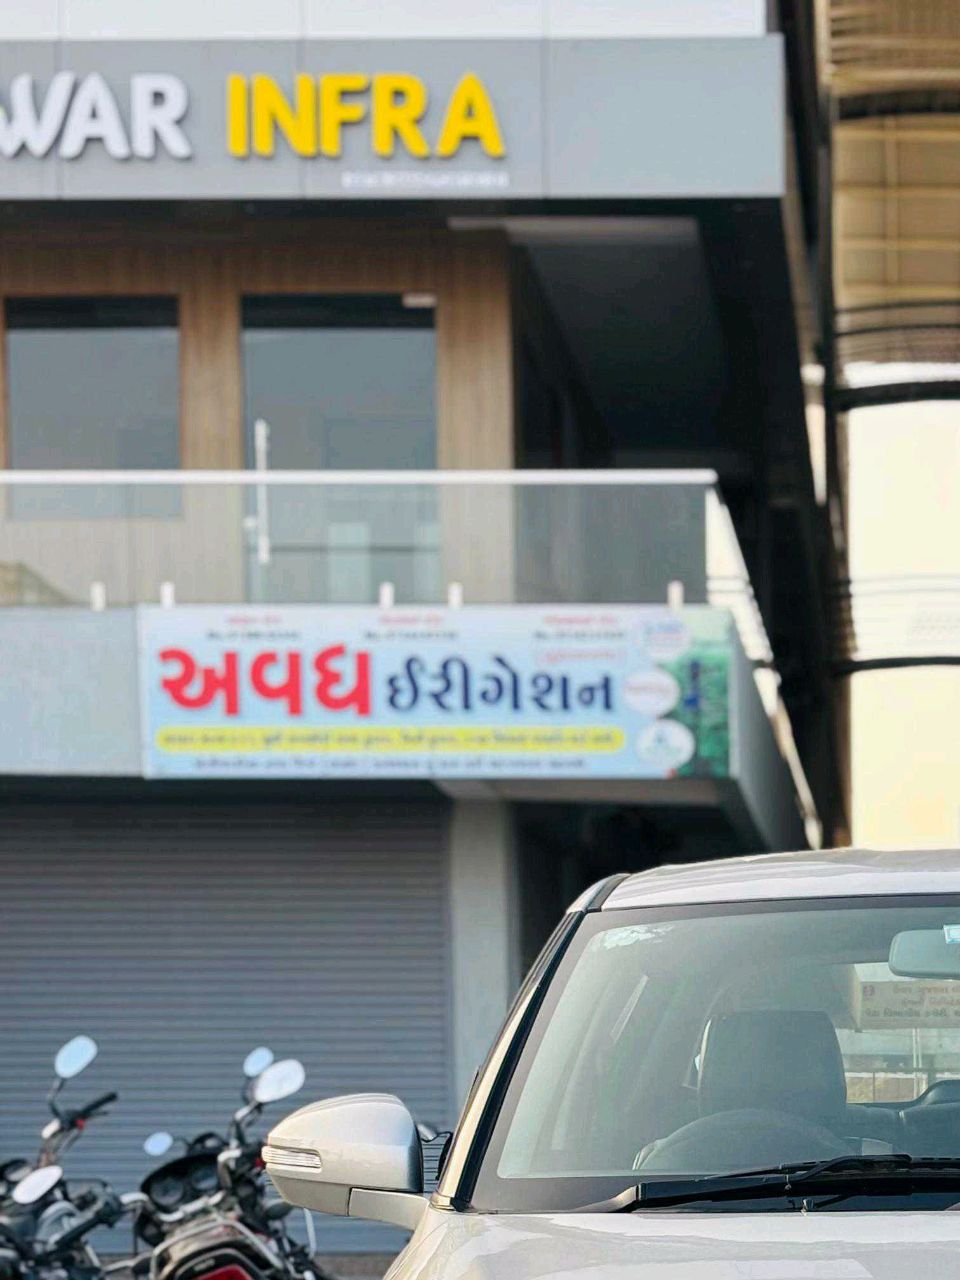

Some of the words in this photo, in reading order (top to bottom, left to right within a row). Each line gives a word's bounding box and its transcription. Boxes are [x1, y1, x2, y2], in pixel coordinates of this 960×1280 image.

[0, 70, 192, 159] WAR
[226, 73, 504, 158] INFRA
[159, 642, 372, 717] અવધ
